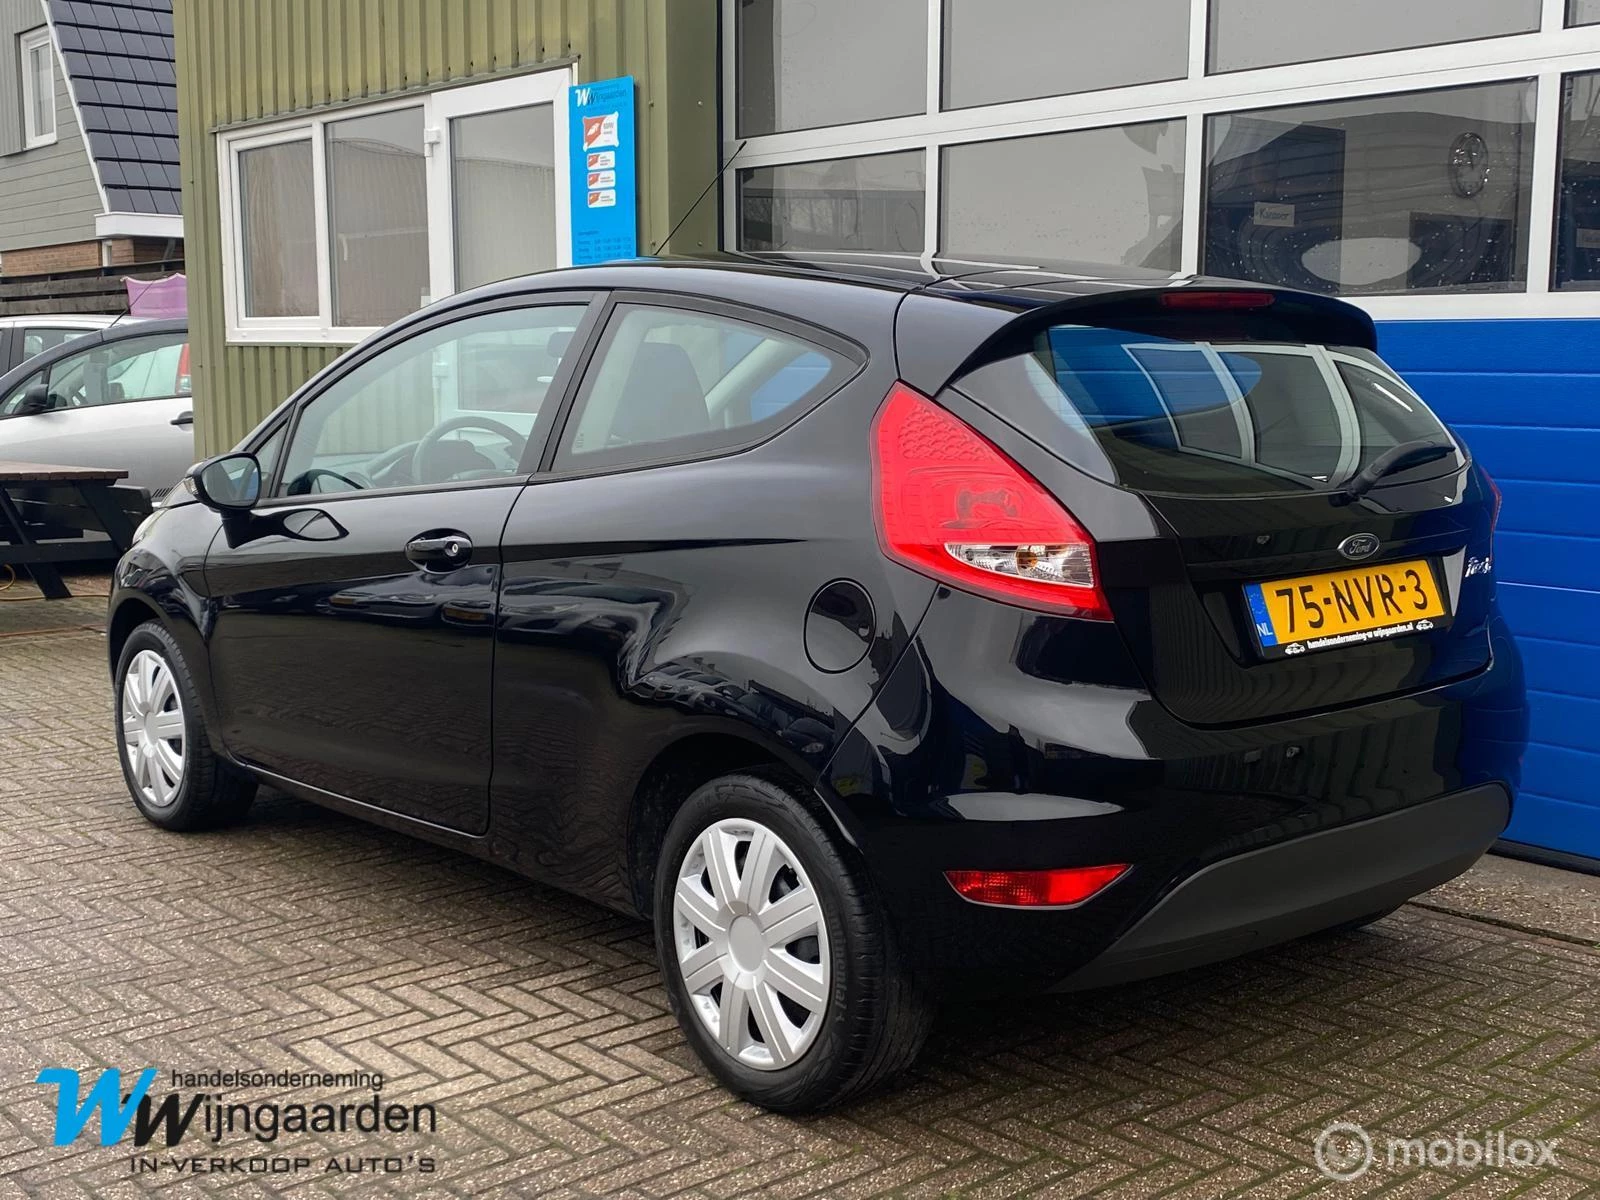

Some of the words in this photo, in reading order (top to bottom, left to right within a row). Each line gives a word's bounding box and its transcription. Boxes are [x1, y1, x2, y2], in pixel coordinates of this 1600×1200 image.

[1349, 538, 1372, 554] Ford
[1275, 568, 1429, 634] 75-NVR-3
[1256, 622, 1273, 637] NL
